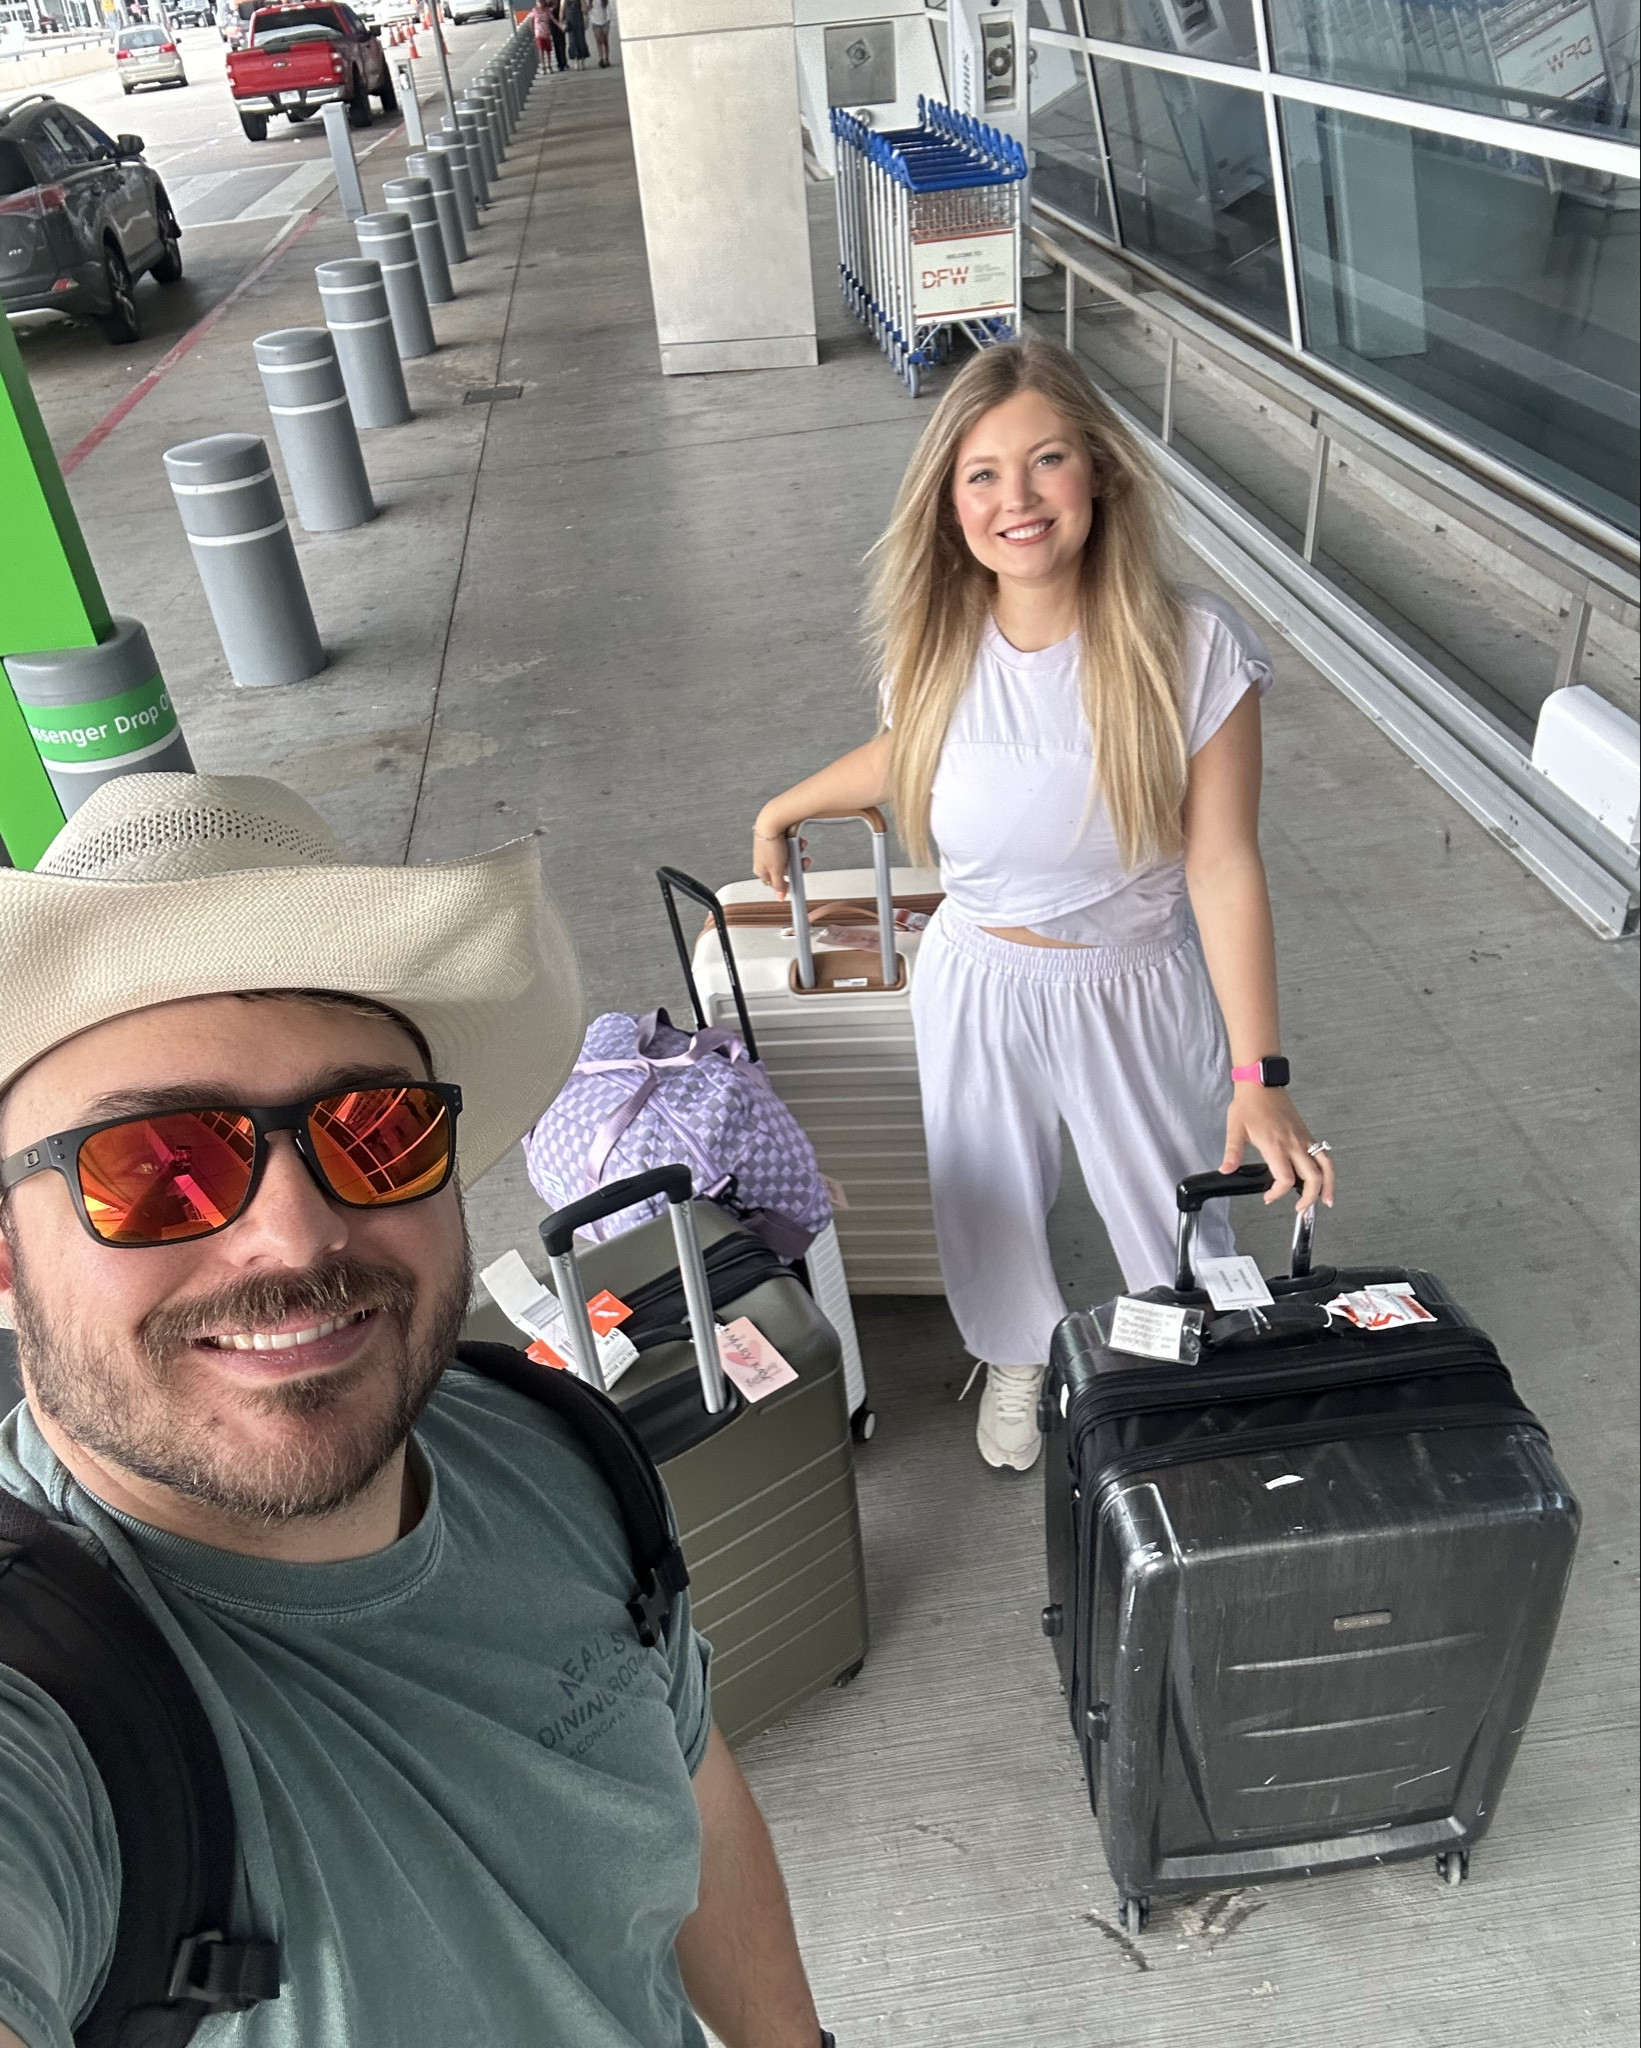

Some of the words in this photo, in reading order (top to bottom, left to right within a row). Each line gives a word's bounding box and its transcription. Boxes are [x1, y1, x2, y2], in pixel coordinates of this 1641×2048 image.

[922, 266, 969, 288] DFW
[29, 724, 108, 748] ssenger
[114, 705, 159, 735] Drop
